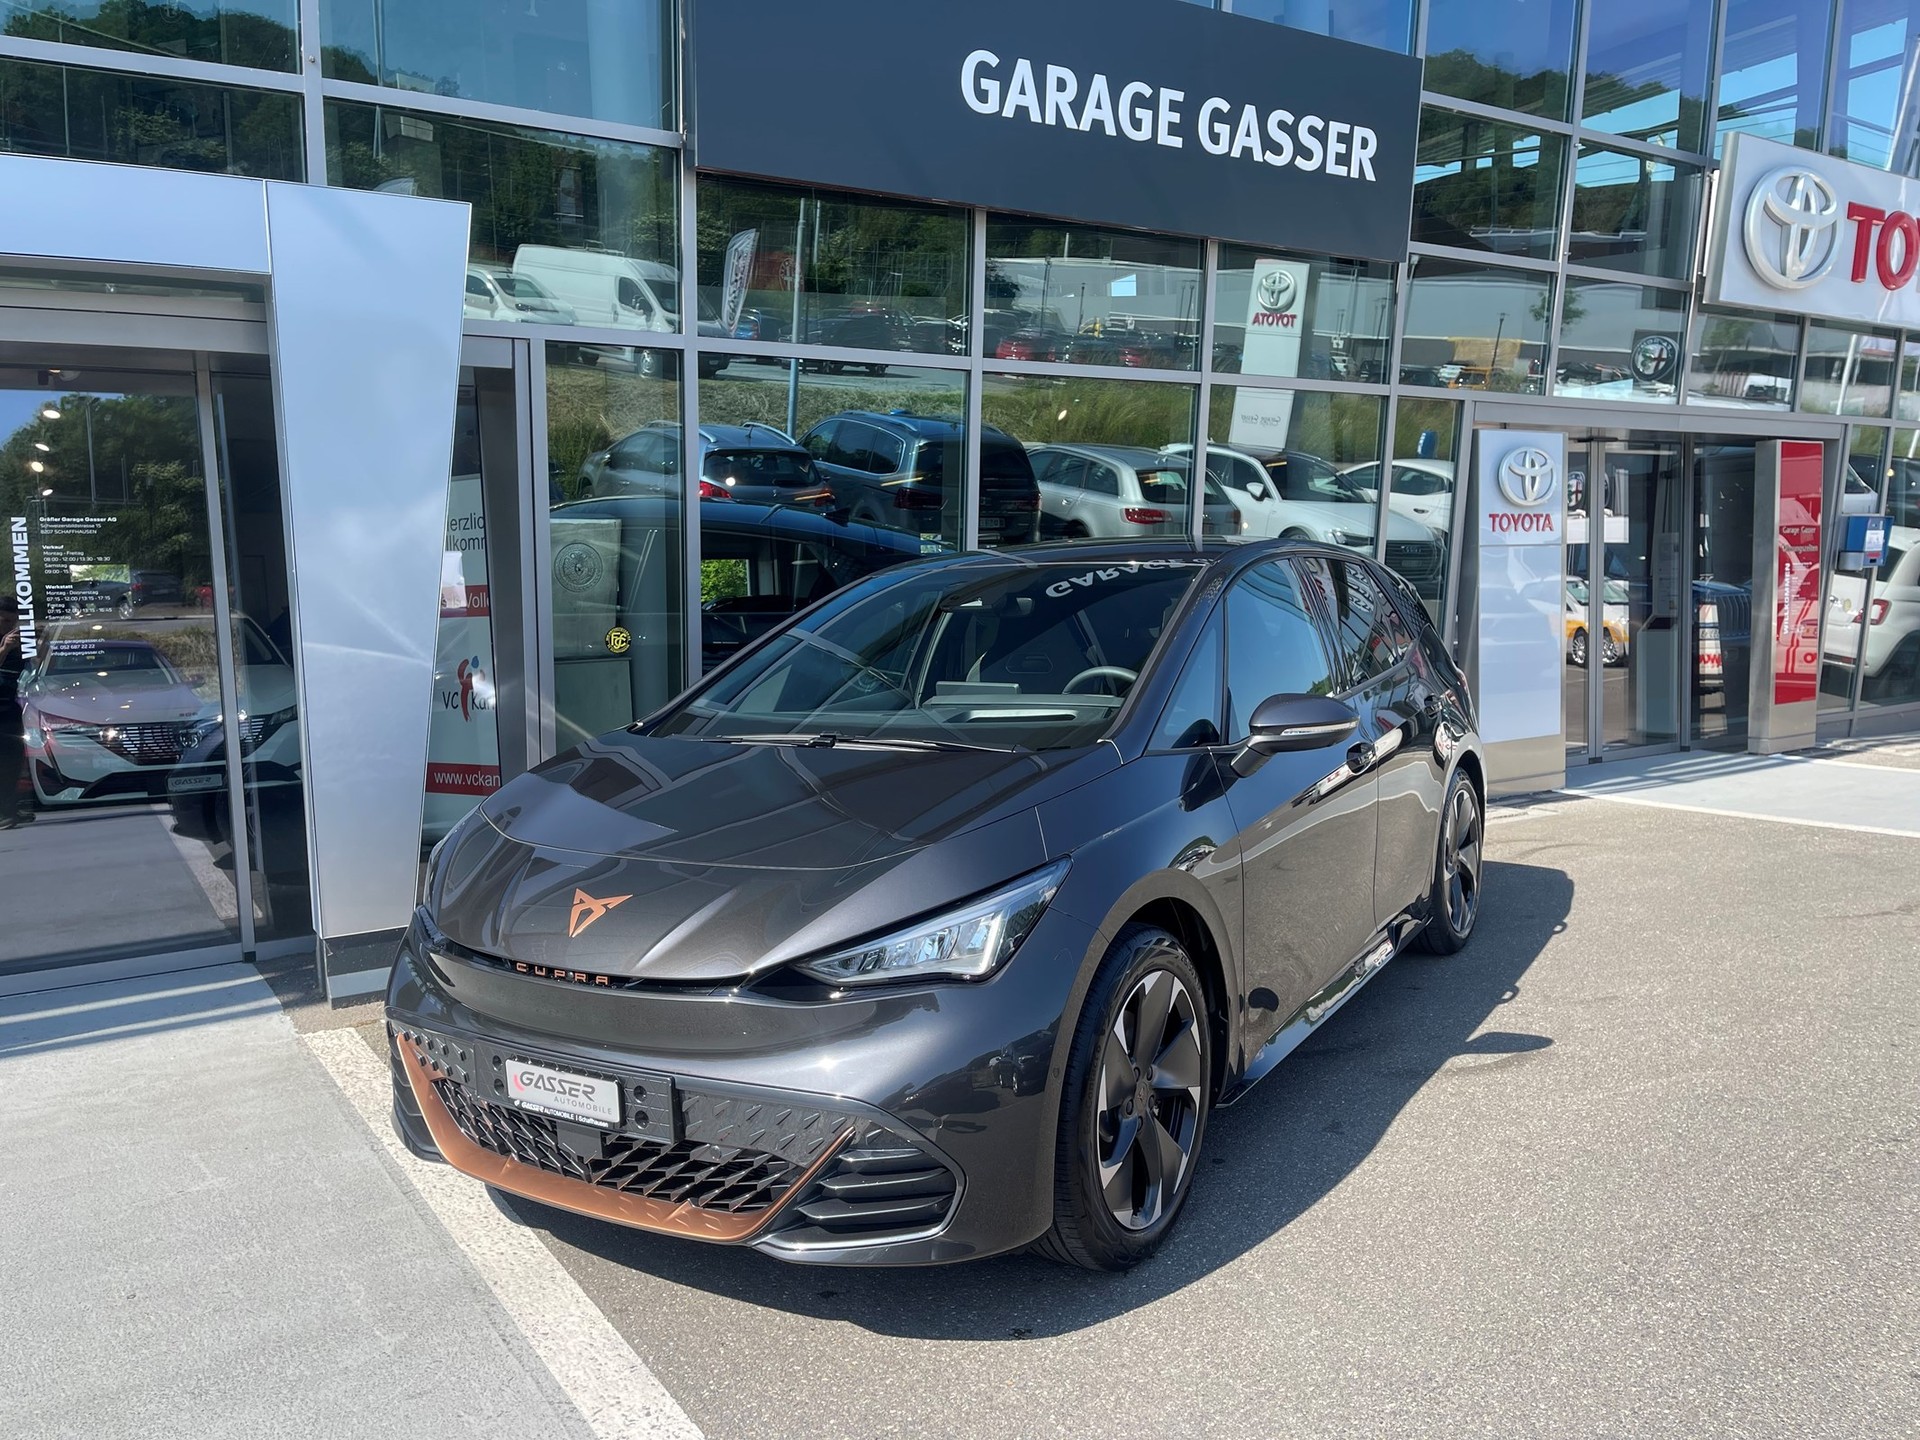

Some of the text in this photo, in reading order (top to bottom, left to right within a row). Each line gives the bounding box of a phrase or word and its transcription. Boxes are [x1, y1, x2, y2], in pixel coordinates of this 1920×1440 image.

[960, 49, 1379, 182] GARAGE GASSER
[1847, 201, 1920, 291] TO
[1488, 512, 1554, 533] TOYOTA
[11, 516, 37, 660] WILLKOMMEN
[1783, 563, 1791, 635] WILLKOMMEN
[516, 962, 609, 986] CUPRA
[520, 1071, 596, 1102] GASSER
[521, 1101, 544, 1113] GASSER
[544, 1106, 575, 1120] AUTOMOBILE
[553, 1096, 613, 1115] AUTOMOBILE
